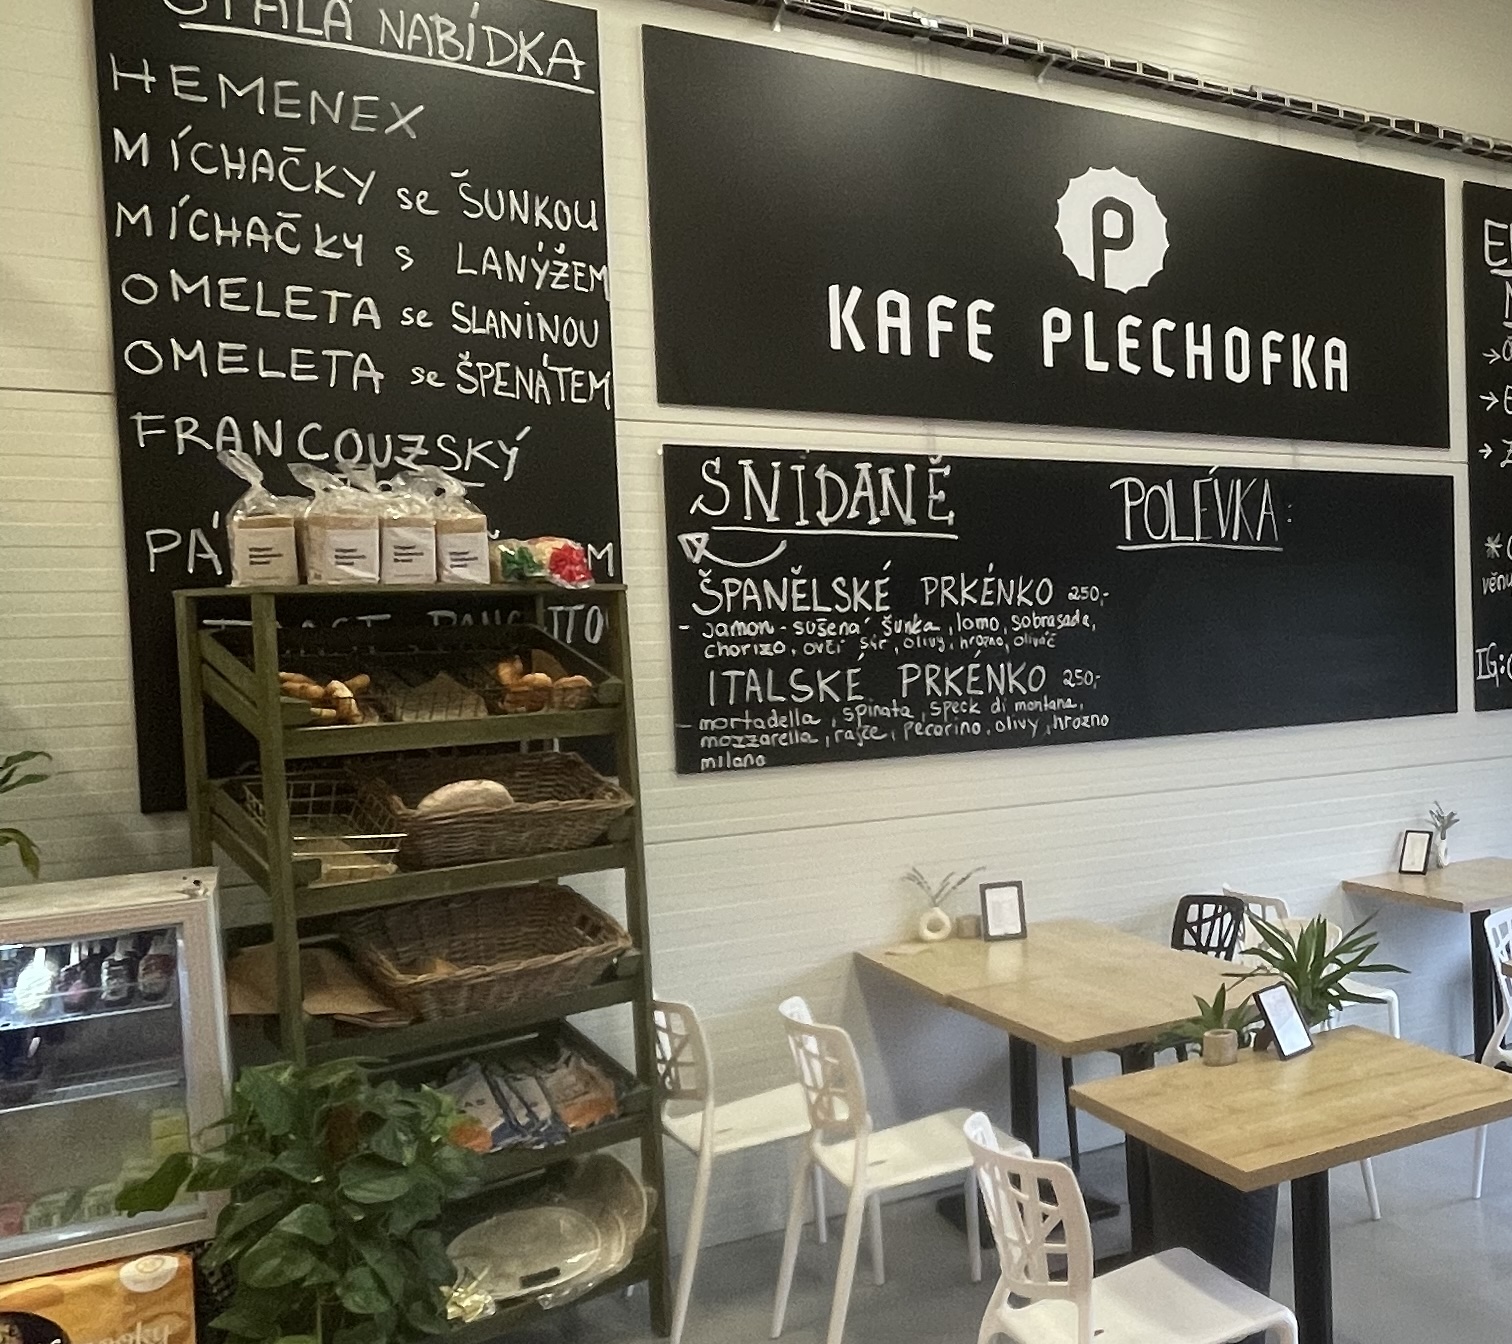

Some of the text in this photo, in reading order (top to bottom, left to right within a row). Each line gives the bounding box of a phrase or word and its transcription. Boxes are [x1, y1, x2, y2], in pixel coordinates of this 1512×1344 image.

[379, 2, 586, 81] NABÍDKA
[109, 53, 425, 139] HEMENEX
[113, 125, 599, 232] MÍCHAČKY se ŠUNKOU
[121, 269, 382, 331] OMELETA
[400, 305, 434, 330] se
[456, 241, 610, 302] LANÝŽEM
[123, 338, 611, 411] OMELETA se ŠPENÁTEM
[827, 283, 1349, 393] KAFE PLECHOFKA
[129, 413, 531, 481] FRANCOUZSKÝ
[689, 450, 954, 528] SNÍDANĚ
[691, 560, 892, 616] ŠPANĚLSKÉ
[920, 562, 1054, 608] PRKÉNKO
[708, 652, 865, 706] ITALSKÉ
[897, 650, 1046, 698] PRKÉNKO
